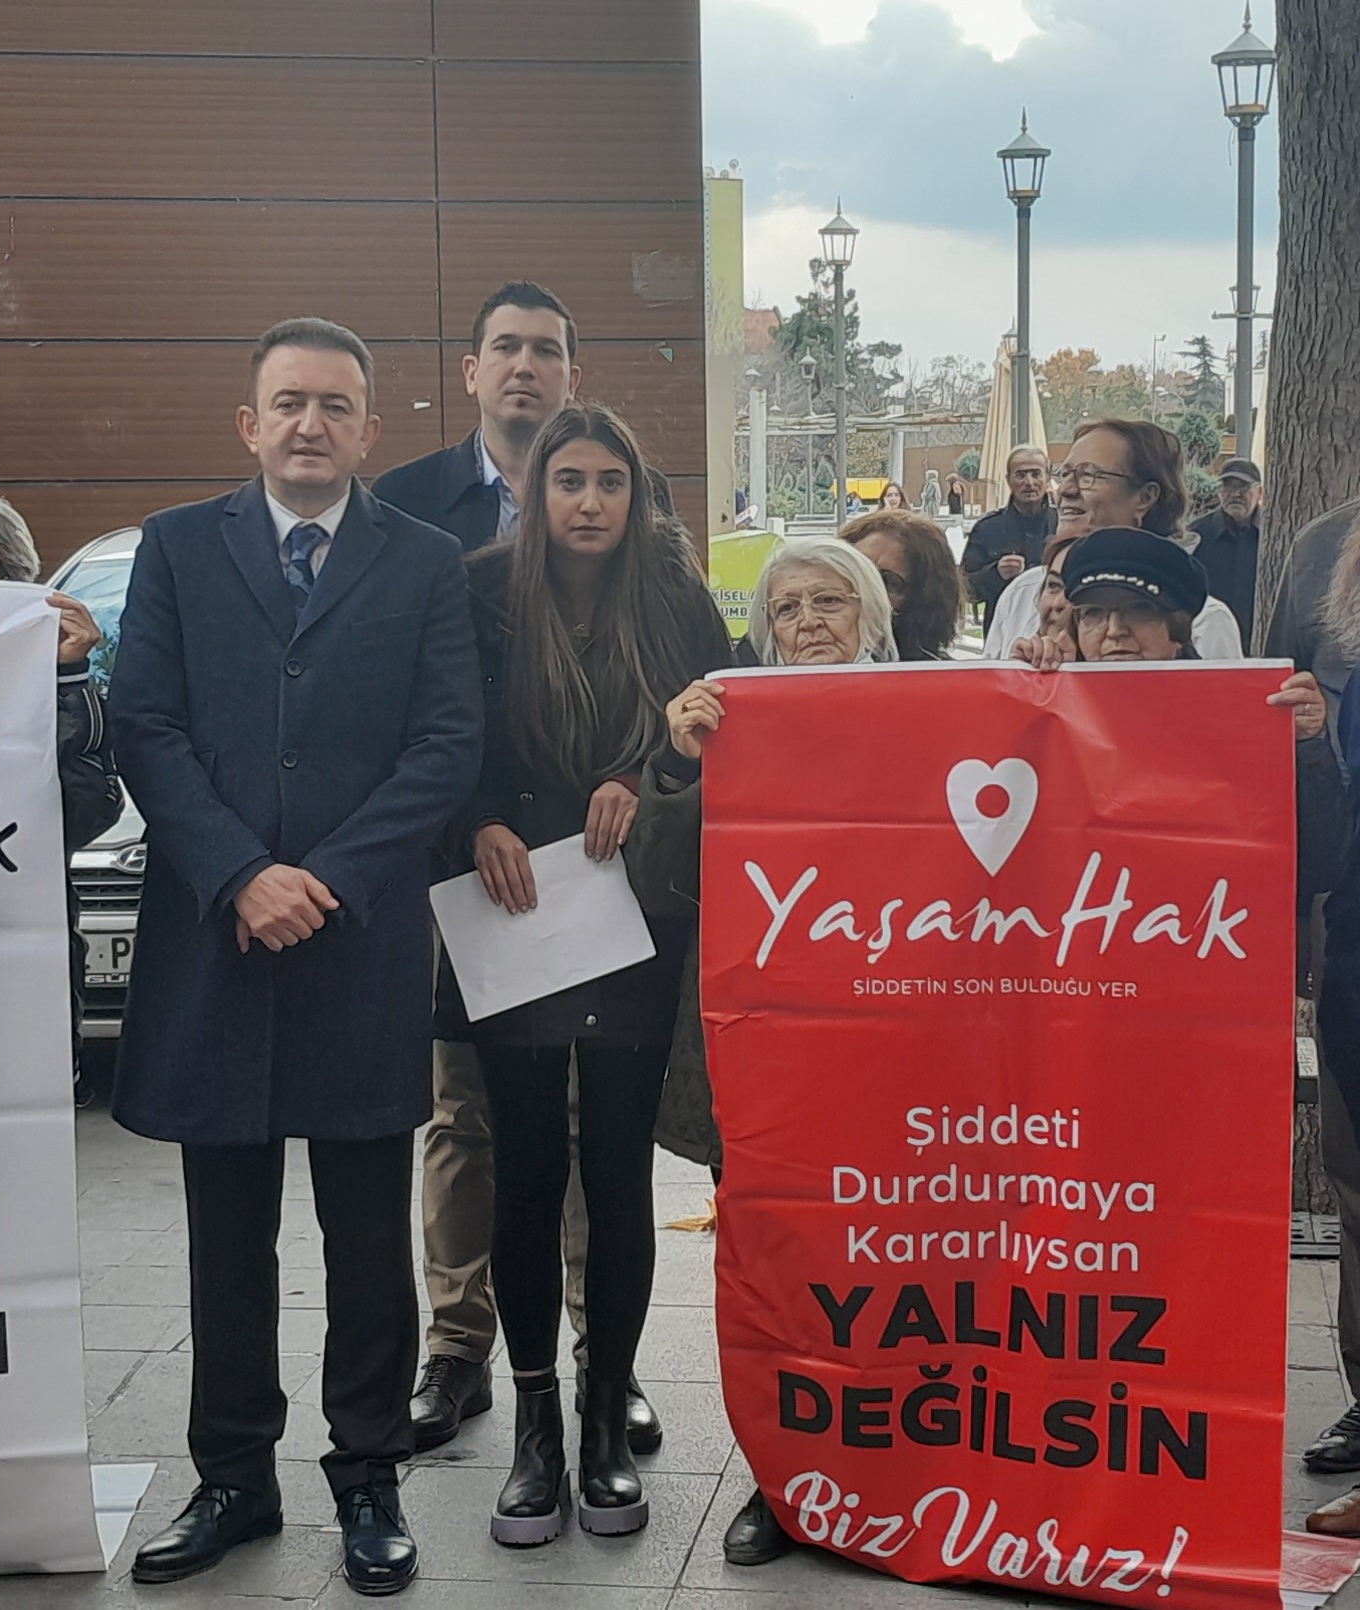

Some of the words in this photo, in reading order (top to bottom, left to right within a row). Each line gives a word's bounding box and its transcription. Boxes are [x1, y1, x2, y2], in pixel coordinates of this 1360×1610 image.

[853, 976, 947, 998] ŞİDDETİN
[953, 978, 994, 995] SON
[1000, 976, 1091, 997] BULDUĞU
[1097, 981, 1138, 998] YER
[905, 1104, 1080, 1156] Şiddeti
[832, 1163, 1156, 1221] Durdurmaya
[848, 1220, 1140, 1274] Kararlıysan
[809, 1281, 1168, 1365] YALNIZ
[777, 1362, 1208, 1480] DEĞİLSİN
